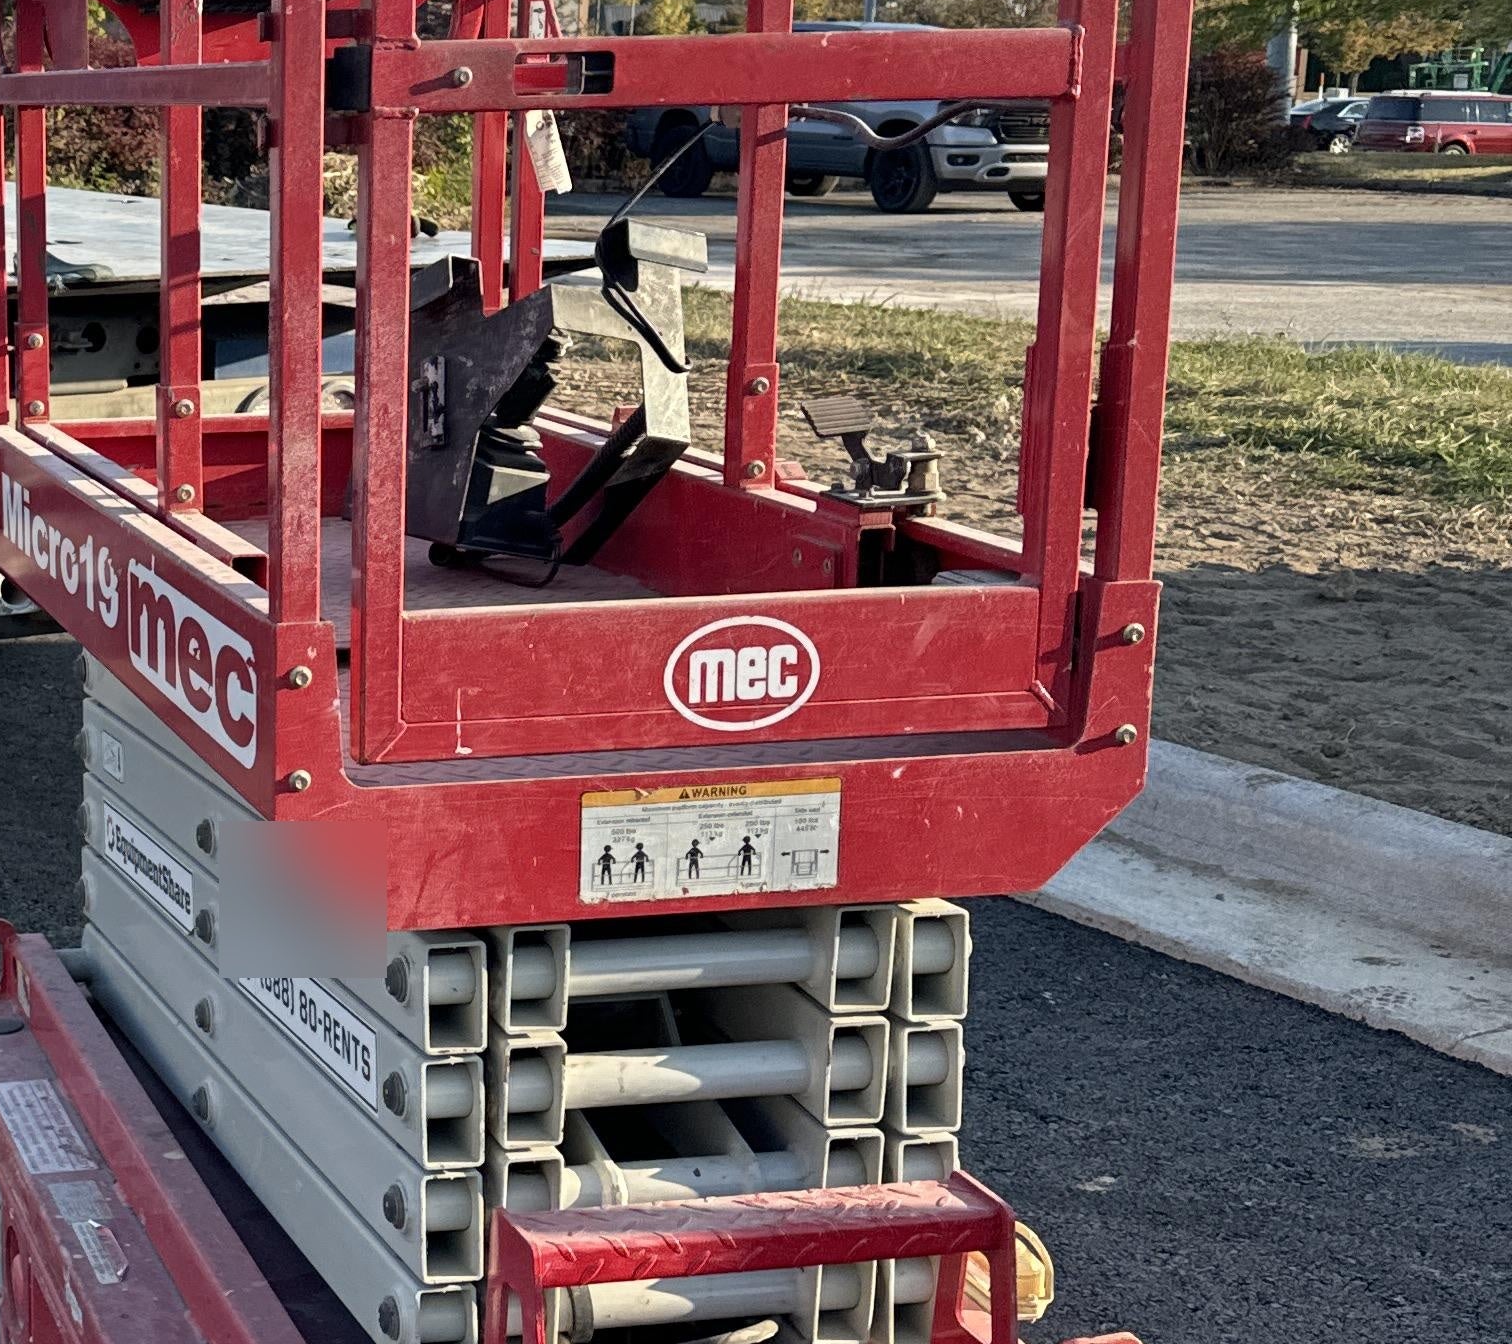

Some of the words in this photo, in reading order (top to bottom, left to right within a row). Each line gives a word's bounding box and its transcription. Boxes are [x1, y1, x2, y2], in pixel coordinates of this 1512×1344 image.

[1, 472, 120, 629] Micro19
[688, 644, 798, 704] mec
[692, 785, 747, 798] WARNING
[115, 823, 192, 915] EquipmentShare
[260, 978, 294, 1016] 88)
[299, 989, 371, 1082] 80-RENTS
